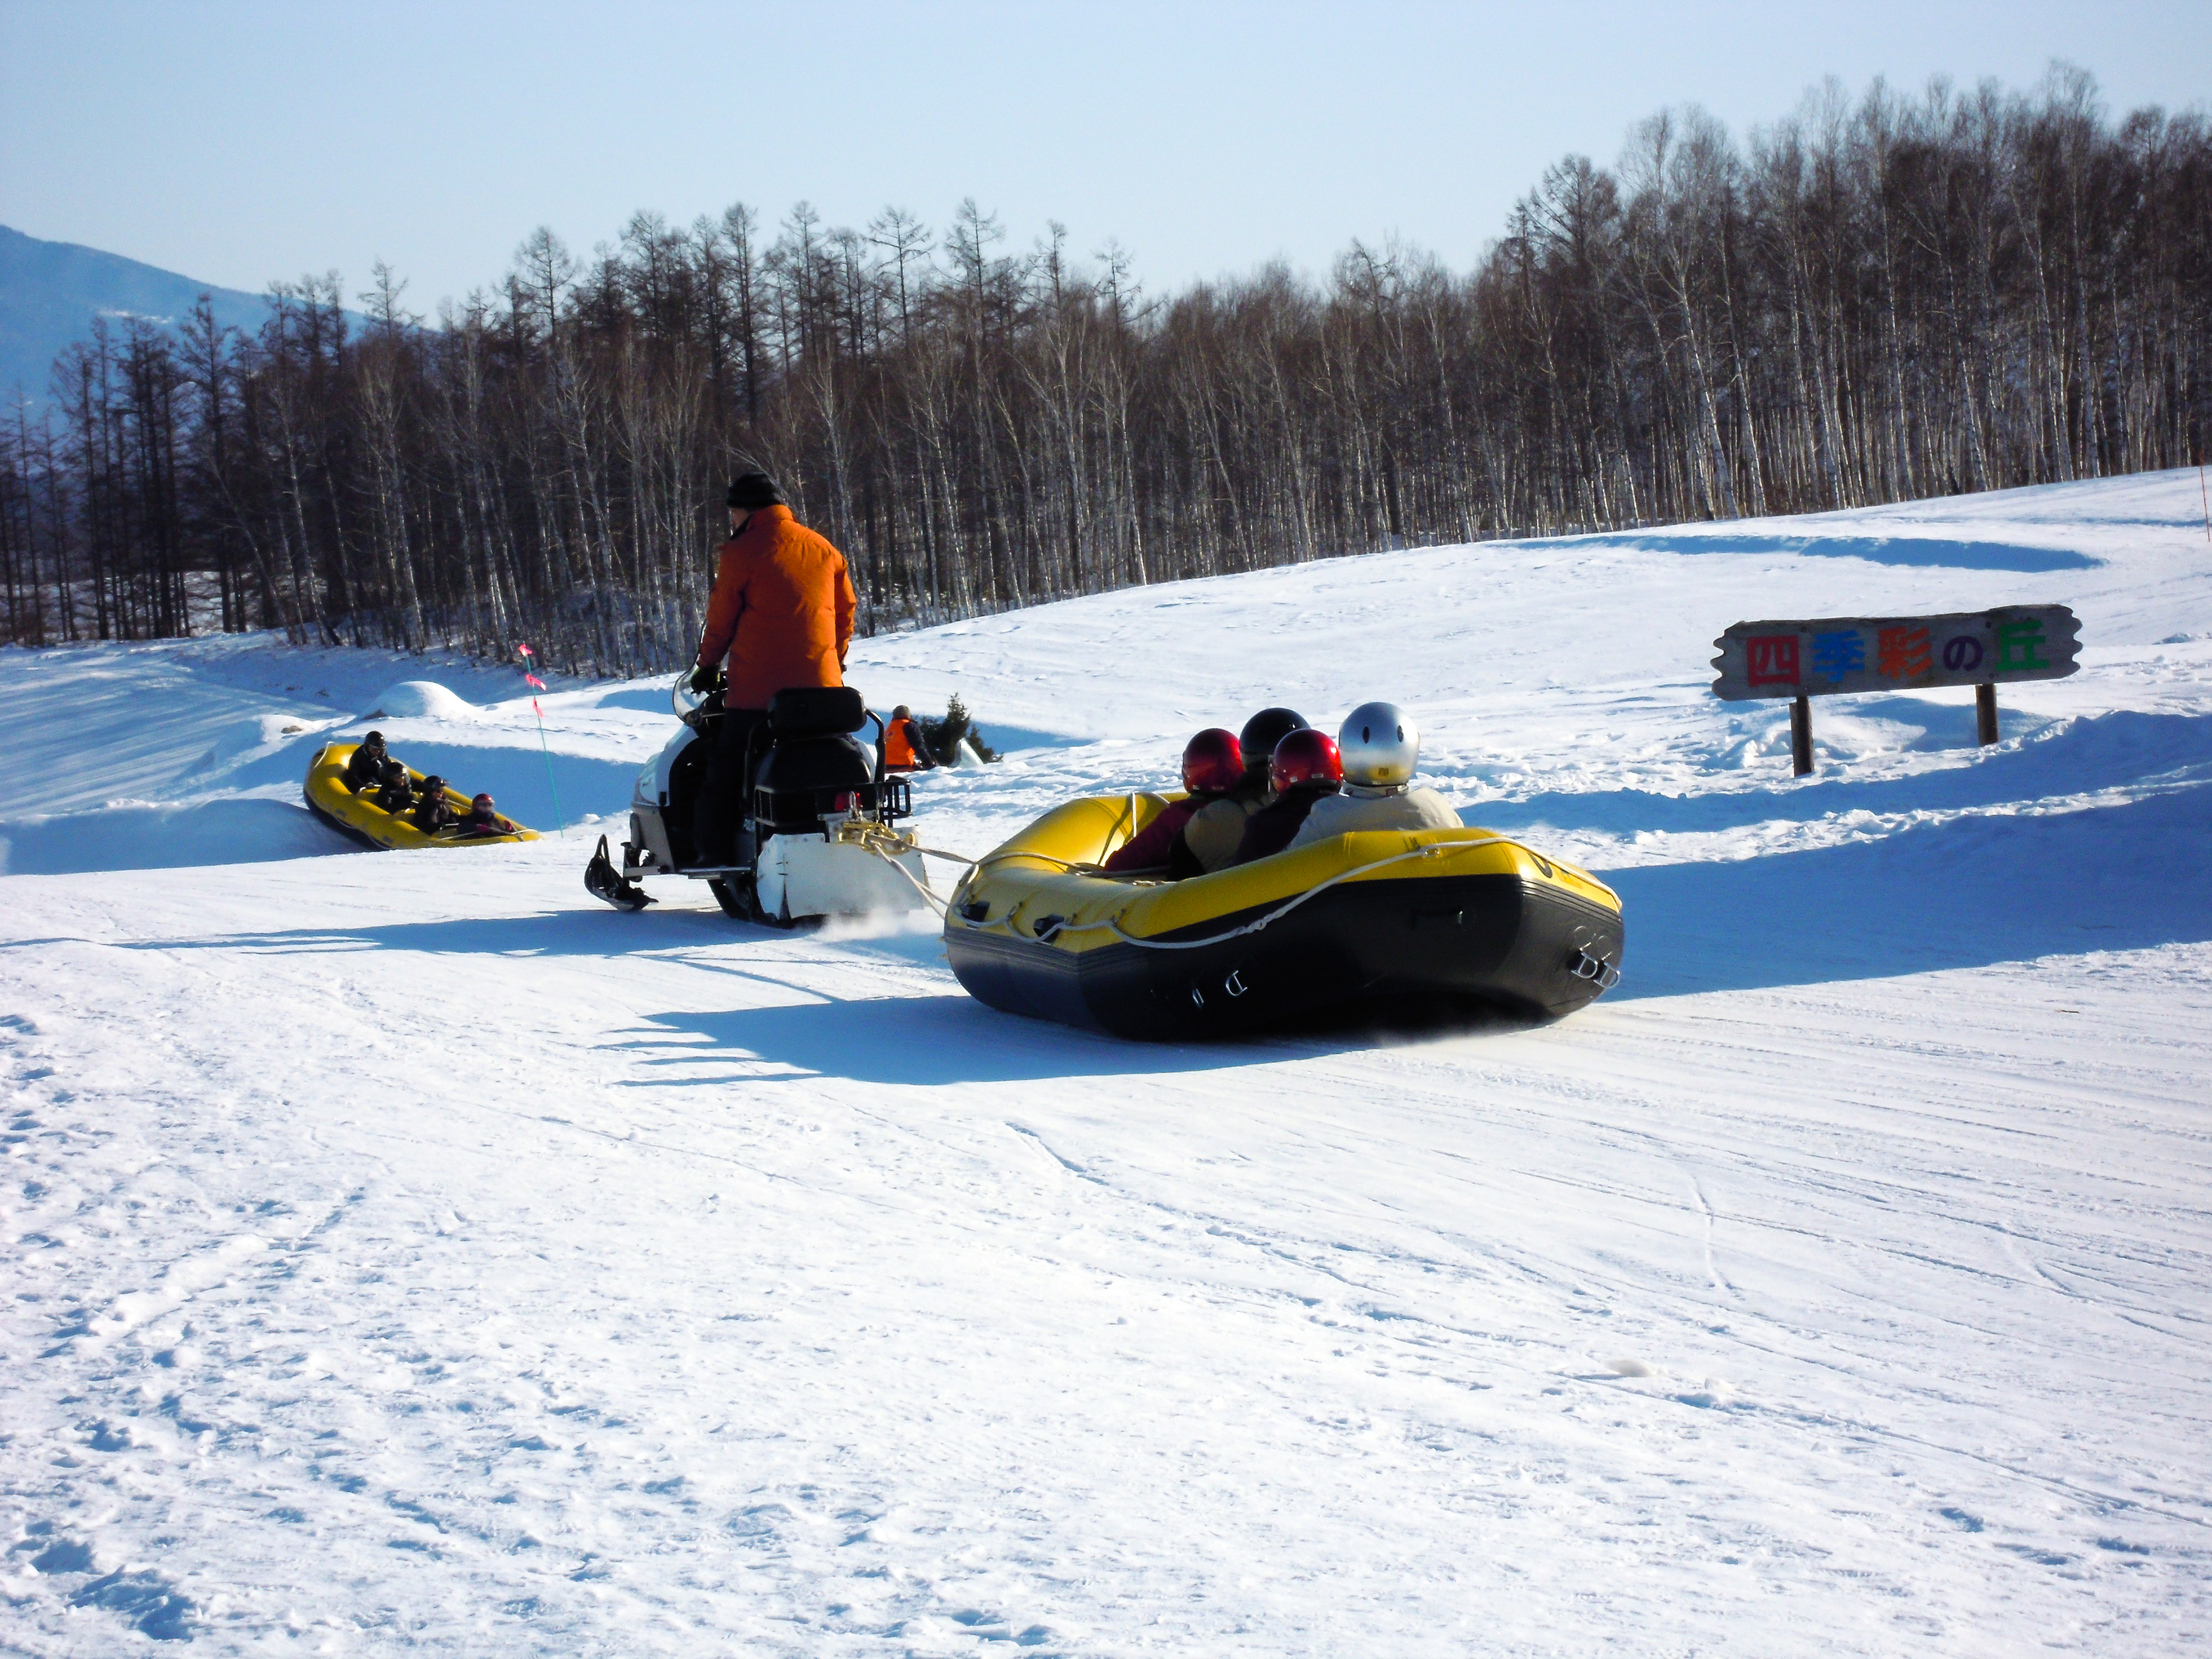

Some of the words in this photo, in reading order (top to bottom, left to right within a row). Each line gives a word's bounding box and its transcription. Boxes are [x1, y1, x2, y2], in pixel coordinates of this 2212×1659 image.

[1746, 620, 2050, 687] 四季彩の丘
